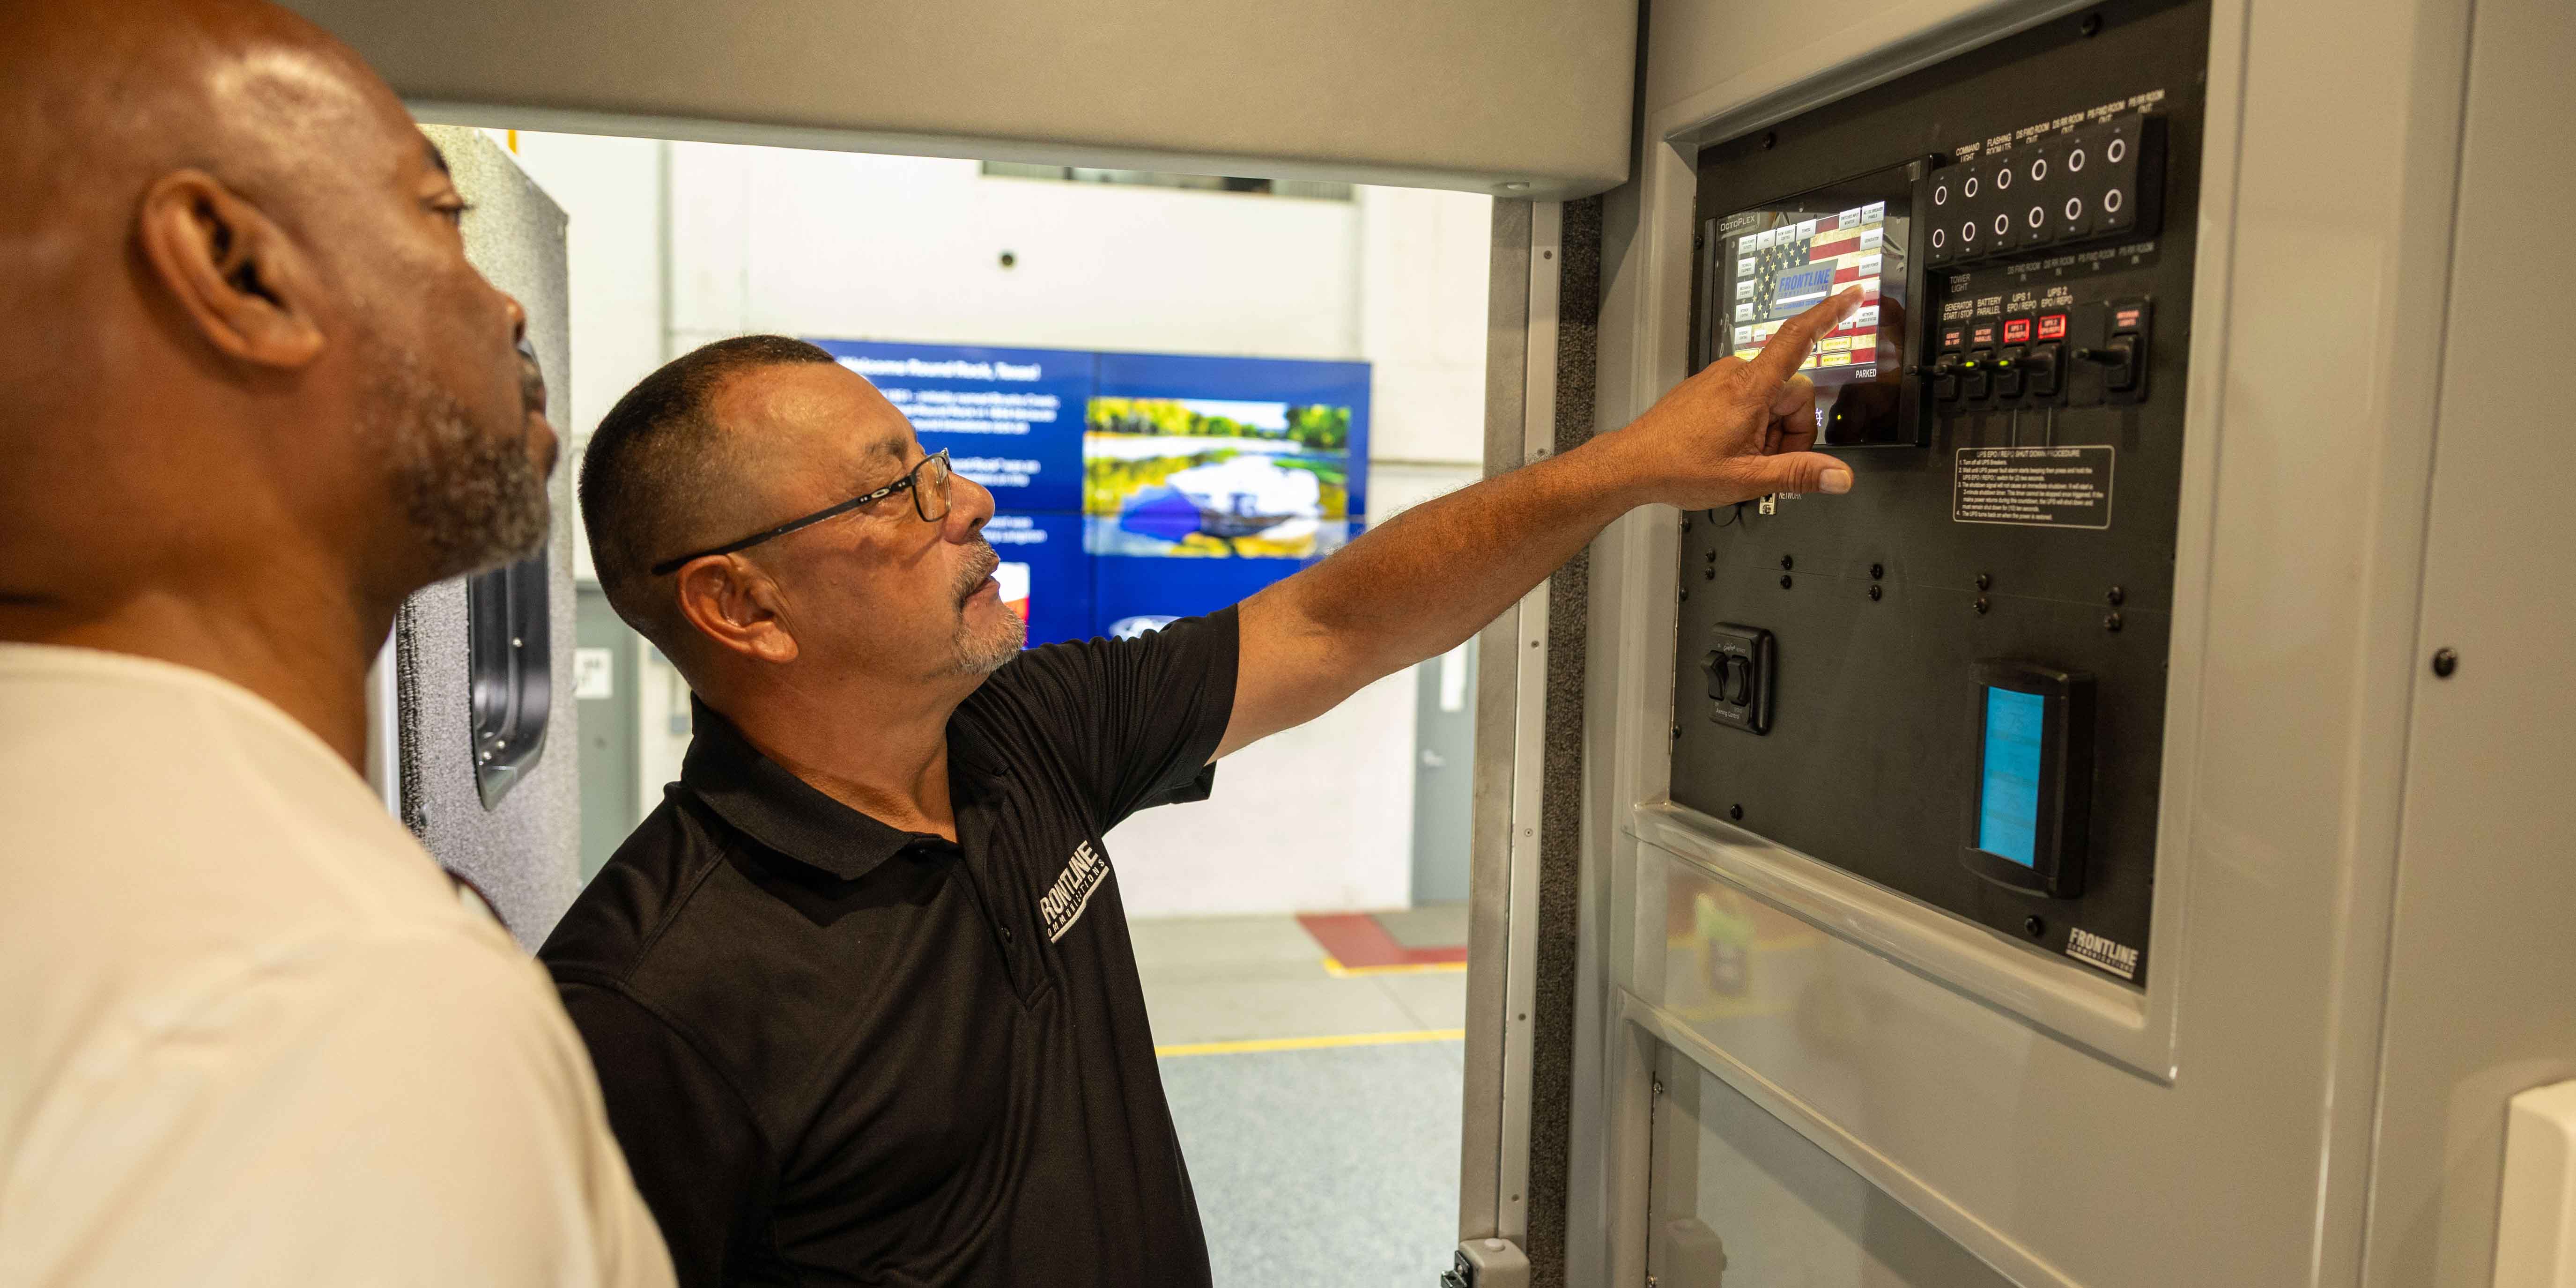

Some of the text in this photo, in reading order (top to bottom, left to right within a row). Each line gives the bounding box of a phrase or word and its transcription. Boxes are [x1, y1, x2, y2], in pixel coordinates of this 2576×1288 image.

[2107, 100, 2125, 114] ROOM
[2068, 112, 2084, 125] ROOM
[2016, 122, 2050, 140] DS FWD ROOM
[1987, 132, 2012, 147] FLASHING
[1956, 142, 1980, 156] COMMAND
[1986, 145, 2001, 156] ROOM
[1961, 153, 1974, 162] LIGHT
[2025, 262, 2041, 272] ROOM
[2059, 256, 2074, 267] ROOM
[1779, 268, 1831, 292] FRONTLINE
[1950, 273, 1970, 284] TOWER
[1951, 284, 1968, 293] LIGHT
[2047, 286, 2067, 296] UPS 2
[1977, 296, 2001, 306] BATTERY
[2012, 292, 2031, 302] UPS 1
[2041, 298, 2052, 308] EPO
[2056, 295, 2073, 306] REPO
[1945, 301, 1972, 312] GENERATOR
[1976, 306, 2000, 316] PARALLEL
[2007, 303, 2018, 312] EPO
[2021, 300, 2036, 310] REPO
[1943, 312, 1957, 321] START
[1960, 309, 1973, 319] STOP
[1975, 328, 1991, 337] BATTERY
[1856, 368, 1876, 378] PARKED
[1716, 708, 1728, 717] Awning
[1040, 840, 1098, 925] RONTLINE
[1047, 859, 1105, 937] OMMUNITIONS
[2069, 927, 2139, 966] FRONTLINE
